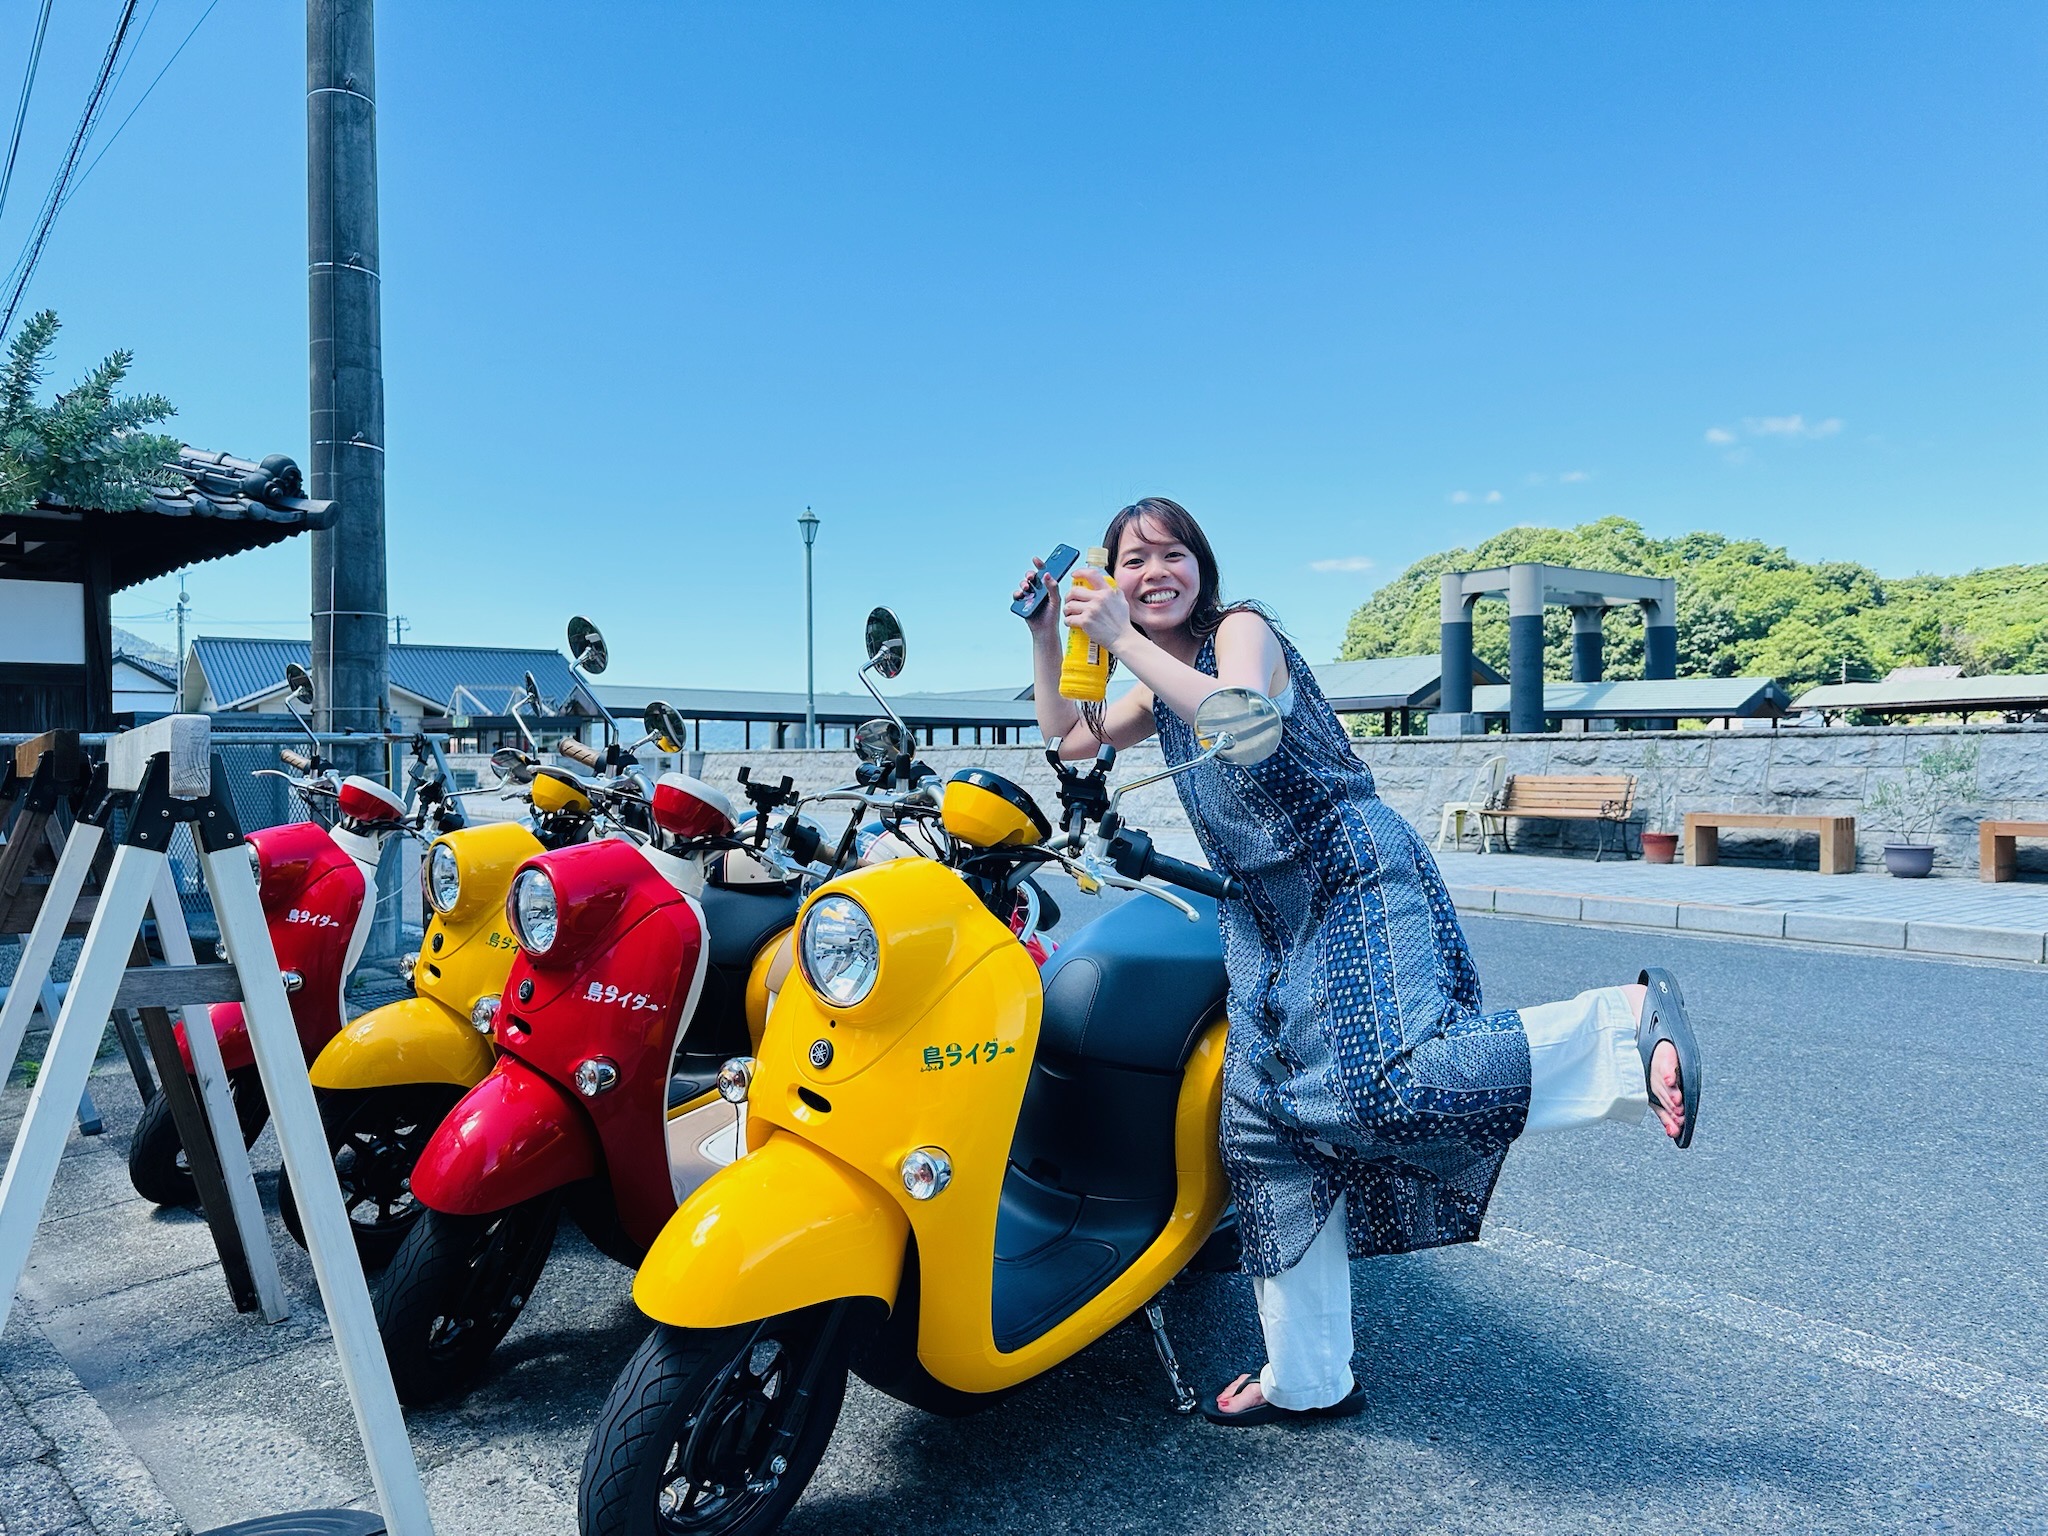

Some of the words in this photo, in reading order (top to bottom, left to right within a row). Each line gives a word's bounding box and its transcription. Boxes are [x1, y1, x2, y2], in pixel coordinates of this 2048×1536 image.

[486, 932, 519, 955] 島ライ
[583, 981, 659, 1012] 島ライダー
[920, 1038, 1016, 1072] 島ライダー
